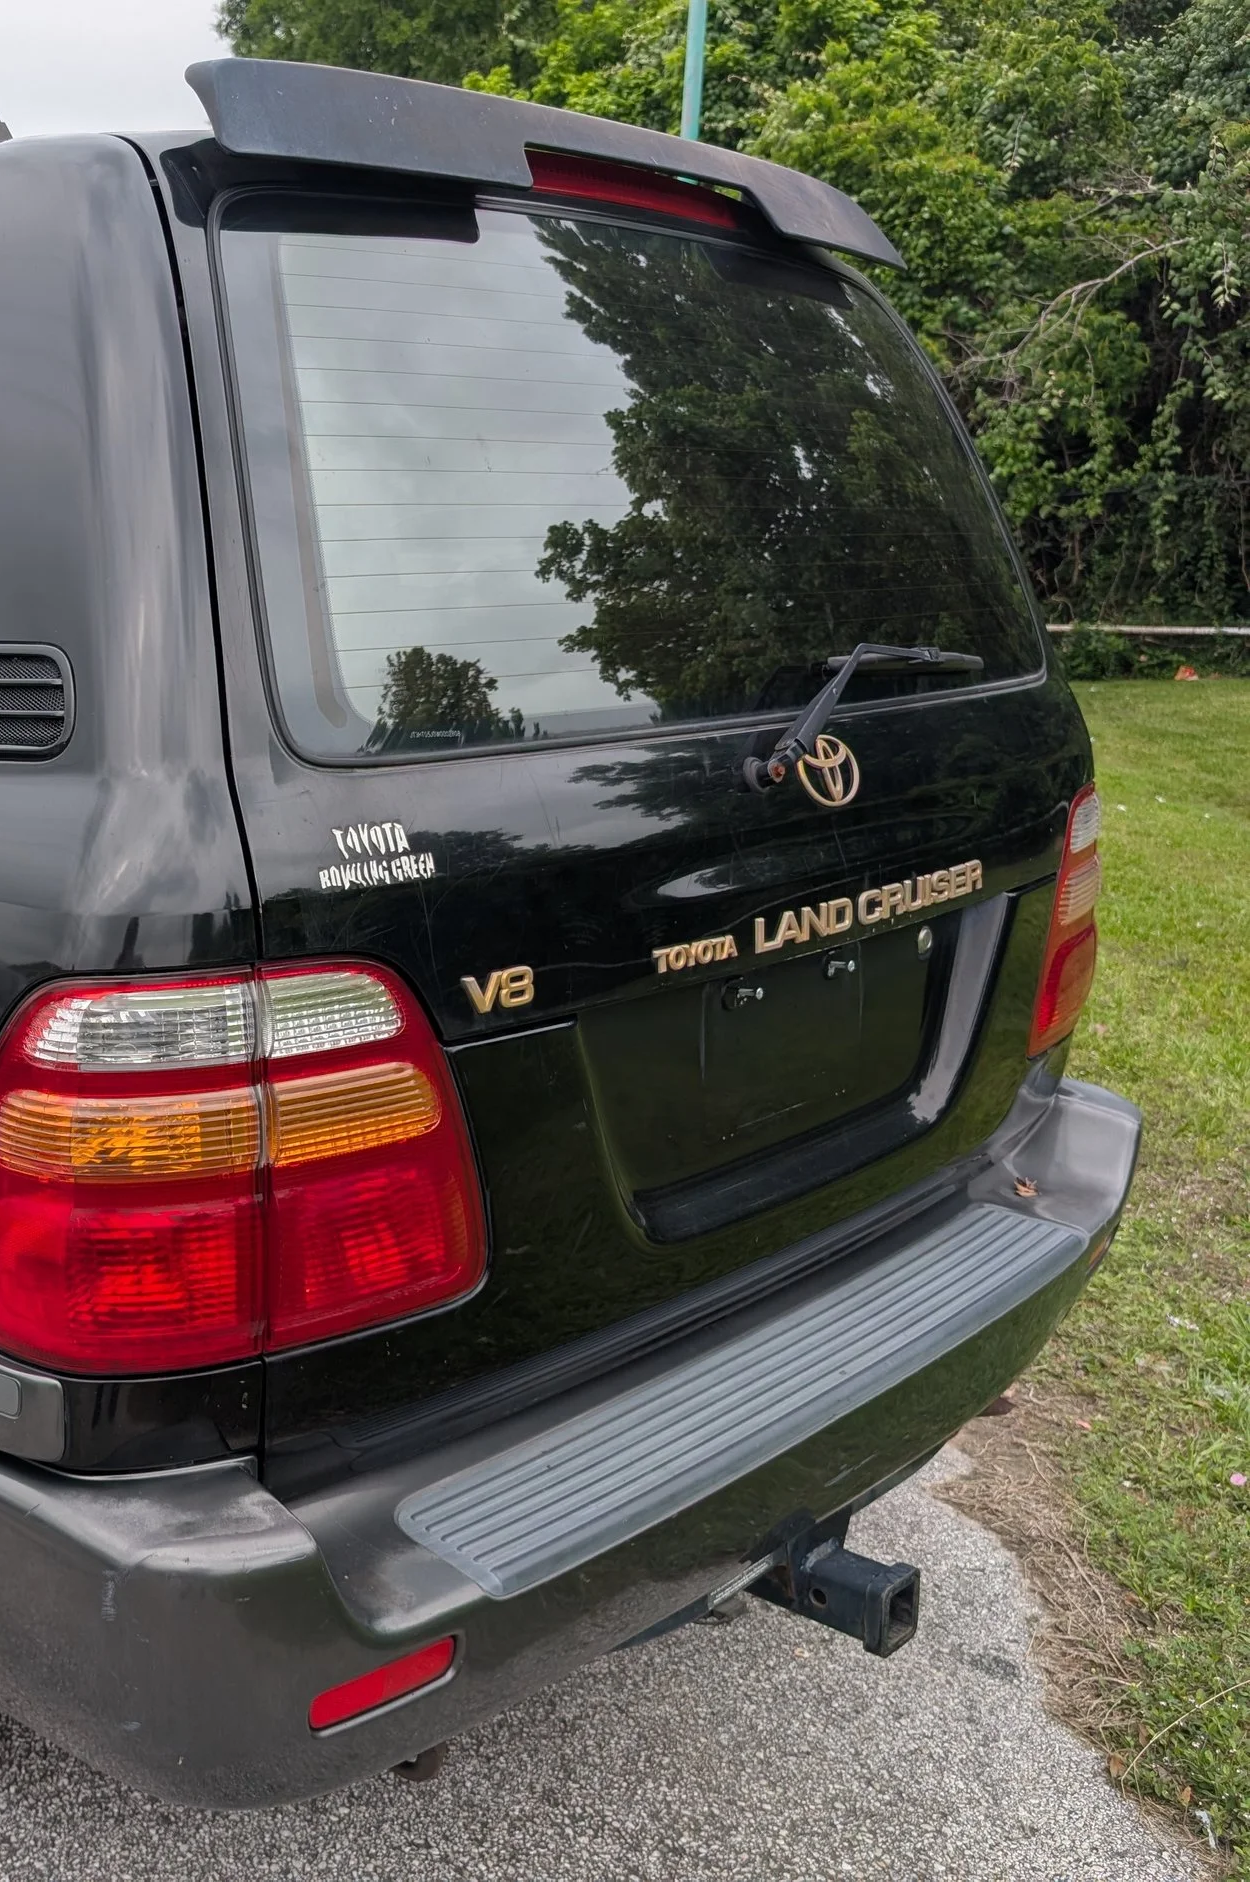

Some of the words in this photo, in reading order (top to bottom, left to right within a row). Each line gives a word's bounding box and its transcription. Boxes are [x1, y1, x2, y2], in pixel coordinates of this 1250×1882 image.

[332, 822, 411, 859] TOYOTA
[391, 852, 436, 883] GREEN
[652, 935, 738, 974] TOYOTA
[754, 898, 853, 954] LAND
[858, 859, 983, 926] CRUISER
[460, 965, 535, 1014] V8
